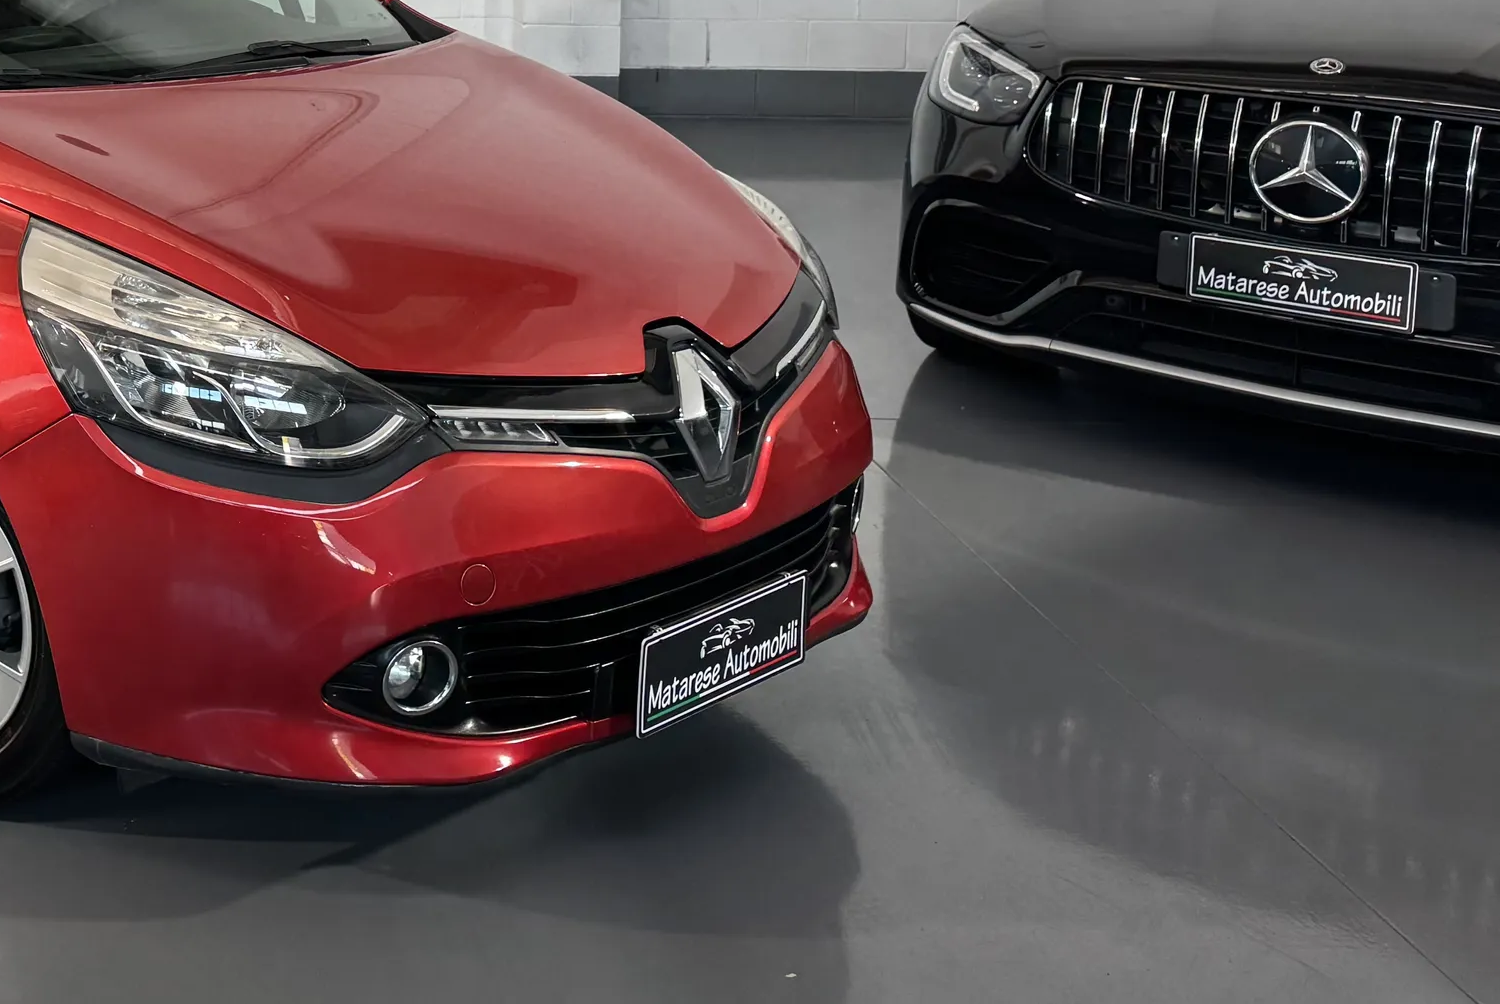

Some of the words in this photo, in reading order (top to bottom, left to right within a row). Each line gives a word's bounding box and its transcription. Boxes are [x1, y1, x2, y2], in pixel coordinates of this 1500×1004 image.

[1197, 265, 1290, 299] Matarese
[1294, 281, 1403, 317] Automobili
[648, 662, 720, 714] Matarese
[723, 619, 799, 680] Automobili
